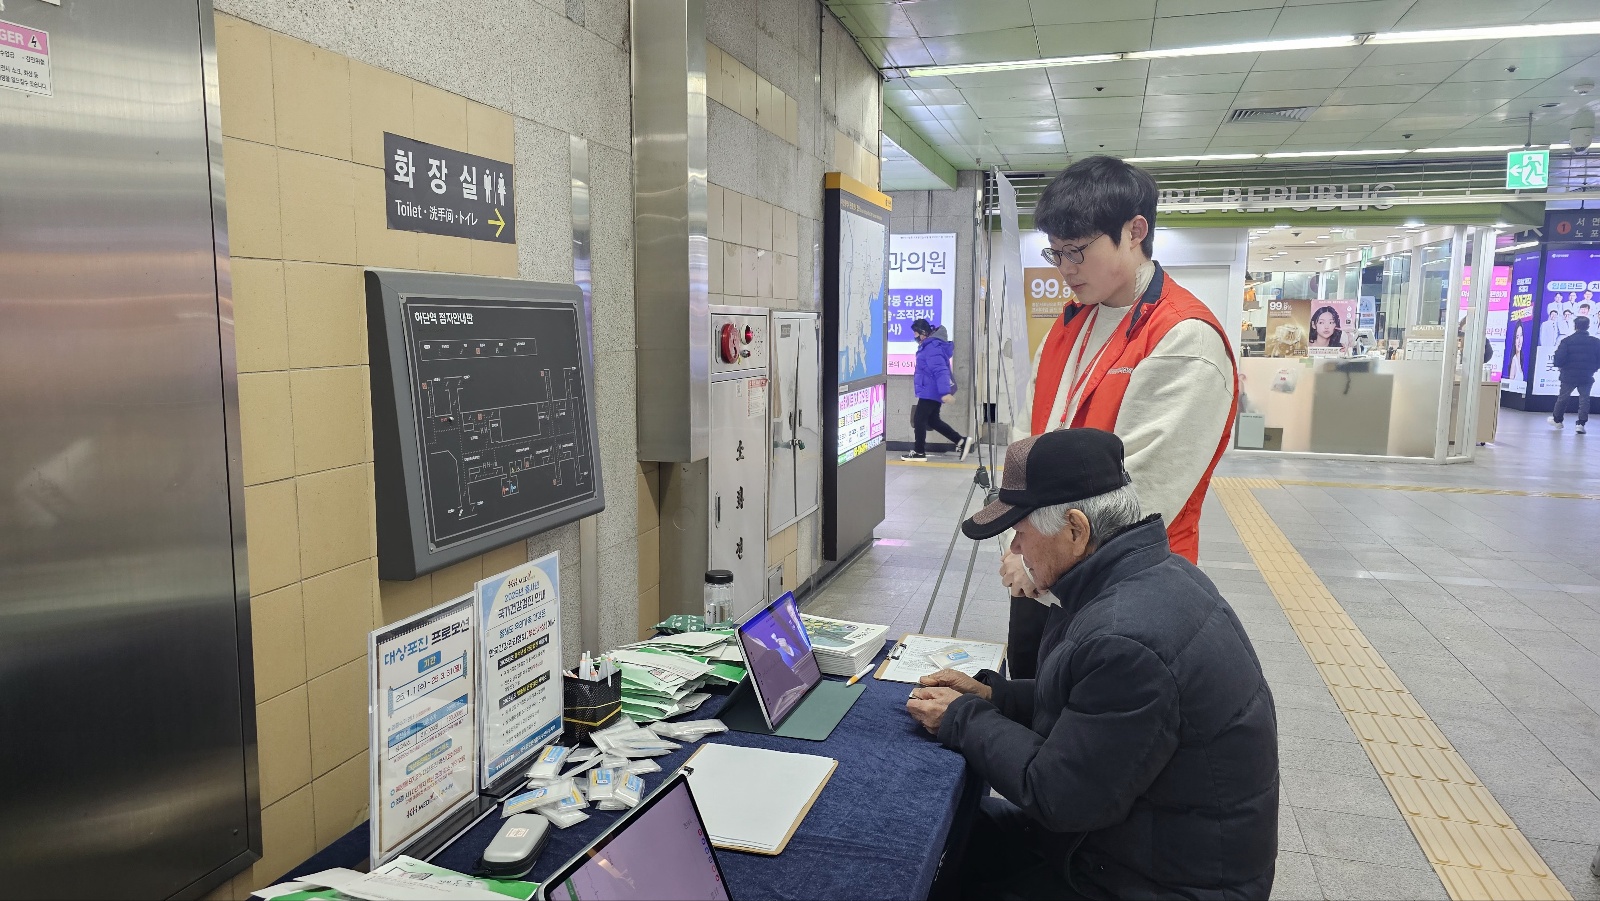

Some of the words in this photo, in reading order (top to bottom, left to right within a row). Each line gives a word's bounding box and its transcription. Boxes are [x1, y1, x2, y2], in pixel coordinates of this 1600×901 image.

[394, 149, 478, 200] 화장실
[395, 200, 422, 218] Toilet
[904, 295, 934, 307] 유선염
[1270, 301, 1292, 311] 99.9%
[414, 311, 438, 325] 하단역
[439, 311, 474, 325] 점자안내판
[498, 594, 534, 619] 국가건강검진
[534, 588, 546, 603] 안내
[384, 635, 429, 666] 대상포진
[431, 616, 470, 646] 프로모션
[423, 656, 437, 668] 기간
